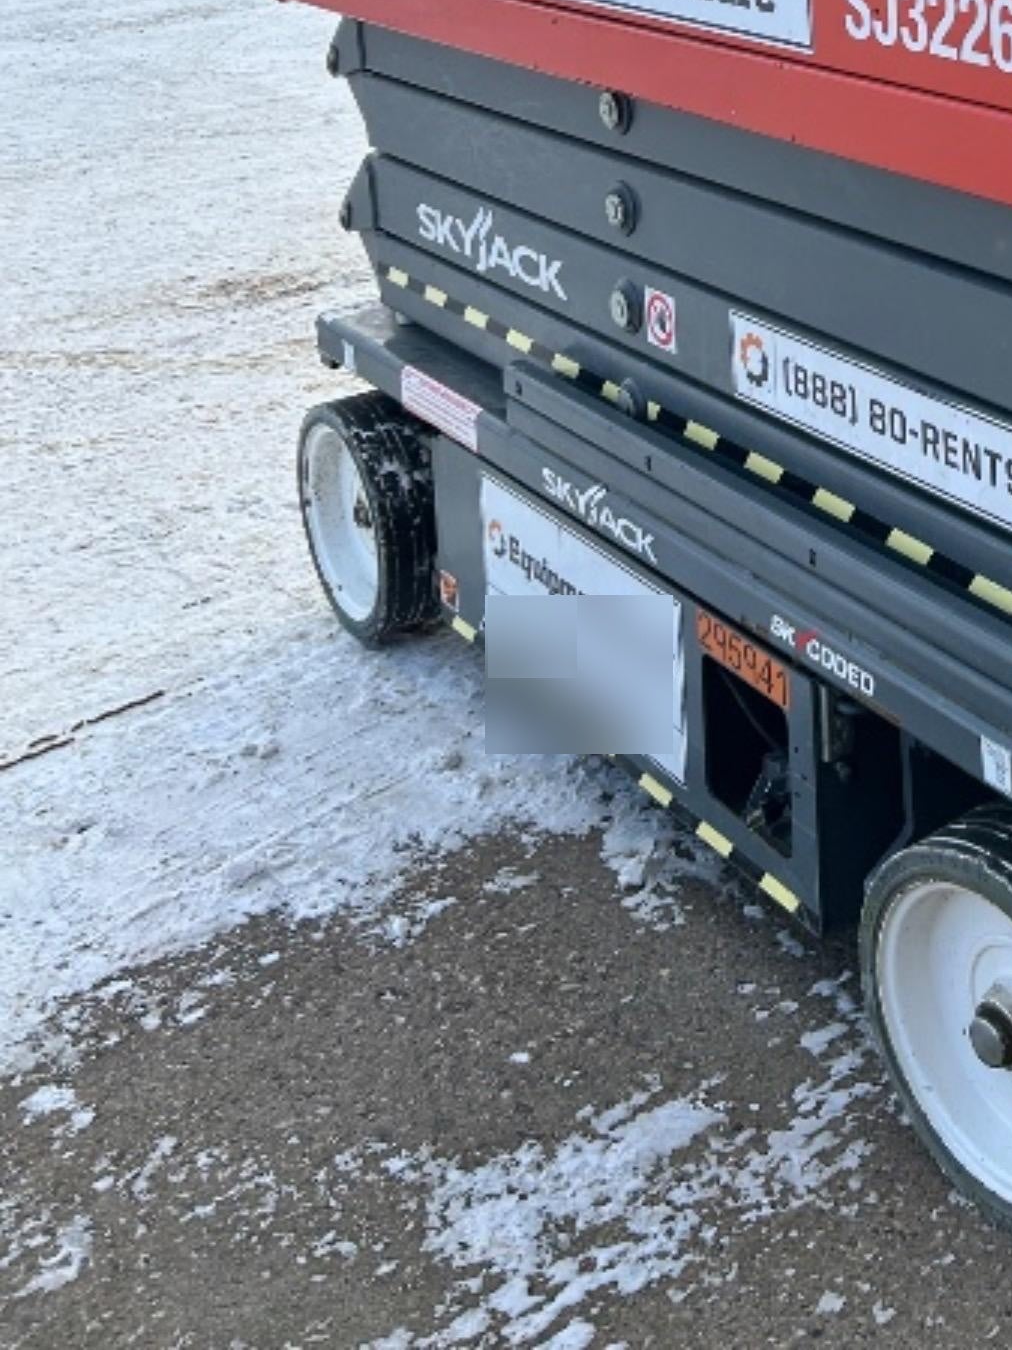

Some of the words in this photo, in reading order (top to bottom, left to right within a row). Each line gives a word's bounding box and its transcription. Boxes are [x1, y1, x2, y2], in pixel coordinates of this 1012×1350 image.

[416, 203, 569, 301] SKYJACK
[781, 355, 859, 426] (888)
[541, 466, 659, 565] SKYJACK
